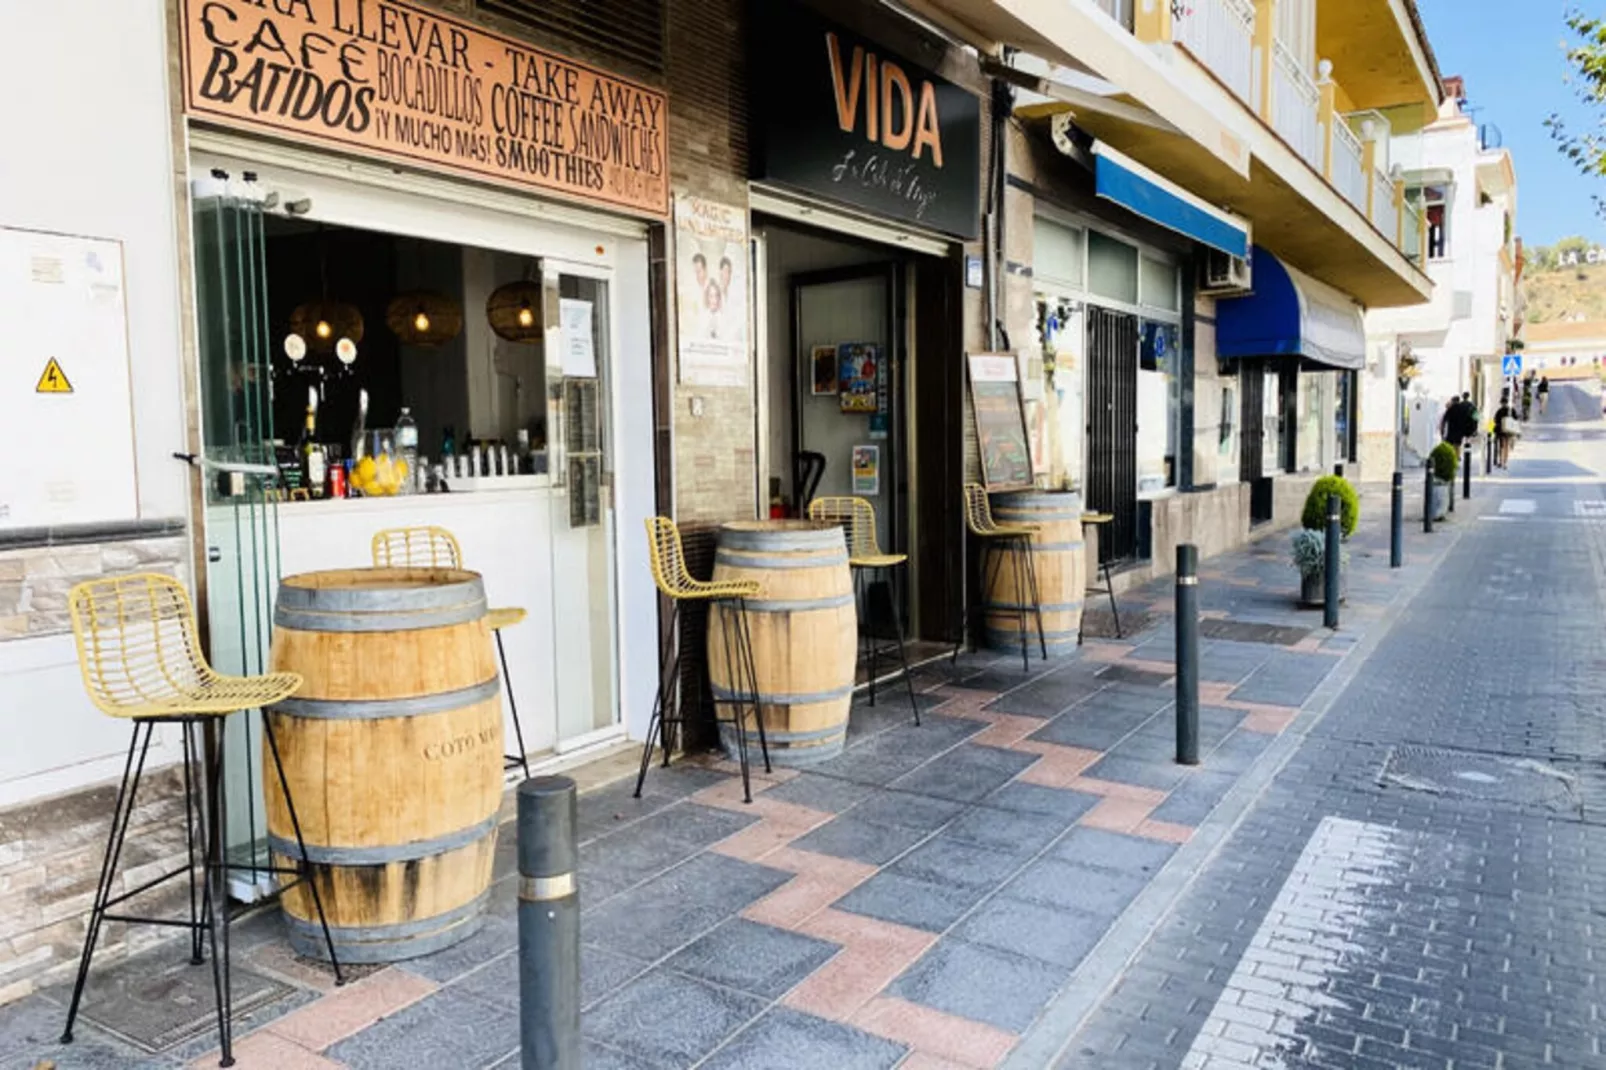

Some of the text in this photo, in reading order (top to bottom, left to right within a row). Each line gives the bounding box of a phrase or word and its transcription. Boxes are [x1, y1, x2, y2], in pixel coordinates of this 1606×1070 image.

[199, 2, 370, 83] CAFÉ
[333, 0, 473, 73] LLEVAR
[505, 47, 580, 105] TAKE
[590, 78, 661, 130] AWAY
[199, 46, 376, 133] BATIDOS
[378, 48, 483, 127] BOCADILLOS
[491, 82, 564, 149] COFFEE
[826, 31, 943, 169] VIDA
[395, 113, 452, 154] MUCHO
[455, 124, 491, 165] MÁS!
[495, 137, 604, 191] SMOOTHIES
[570, 104, 663, 177] SANDWICHES
[1558, 250, 1578, 266] LA
[423, 734, 475, 762] COTO
